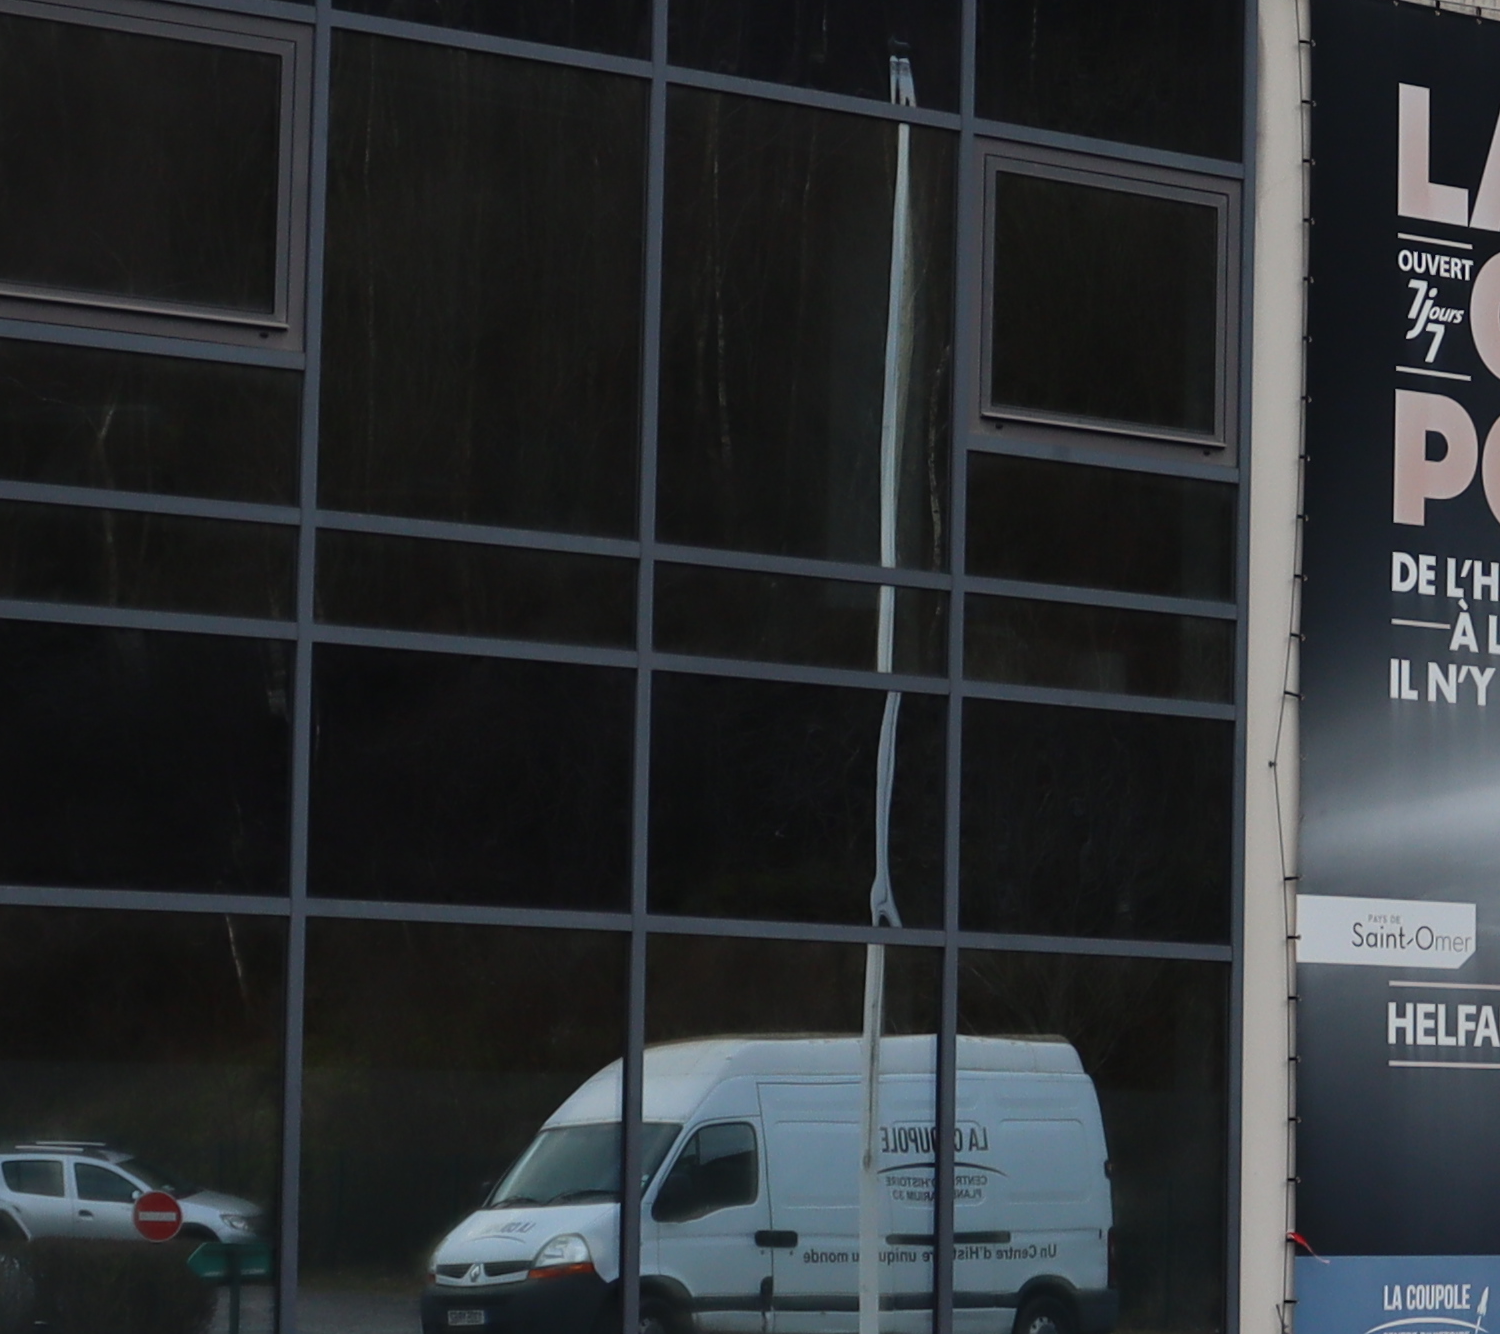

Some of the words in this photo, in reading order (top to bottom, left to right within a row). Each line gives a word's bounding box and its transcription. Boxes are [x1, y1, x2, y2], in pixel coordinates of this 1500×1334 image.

[1398, 249, 1474, 281] OUVERT
[1425, 323, 1445, 363] 7
[1391, 551, 1436, 596] DE
[1450, 598, 1479, 653] À
[1390, 658, 1419, 701] IL
[1427, 662, 1496, 706] N'Y
[1368, 913, 1388, 924] PAYS
[1390, 915, 1401, 925] DE
[1351, 922, 1472, 953] Saint-Omer
[1384, 1284, 1402, 1311] LA
[1406, 1284, 1471, 1310] COUPOLE
